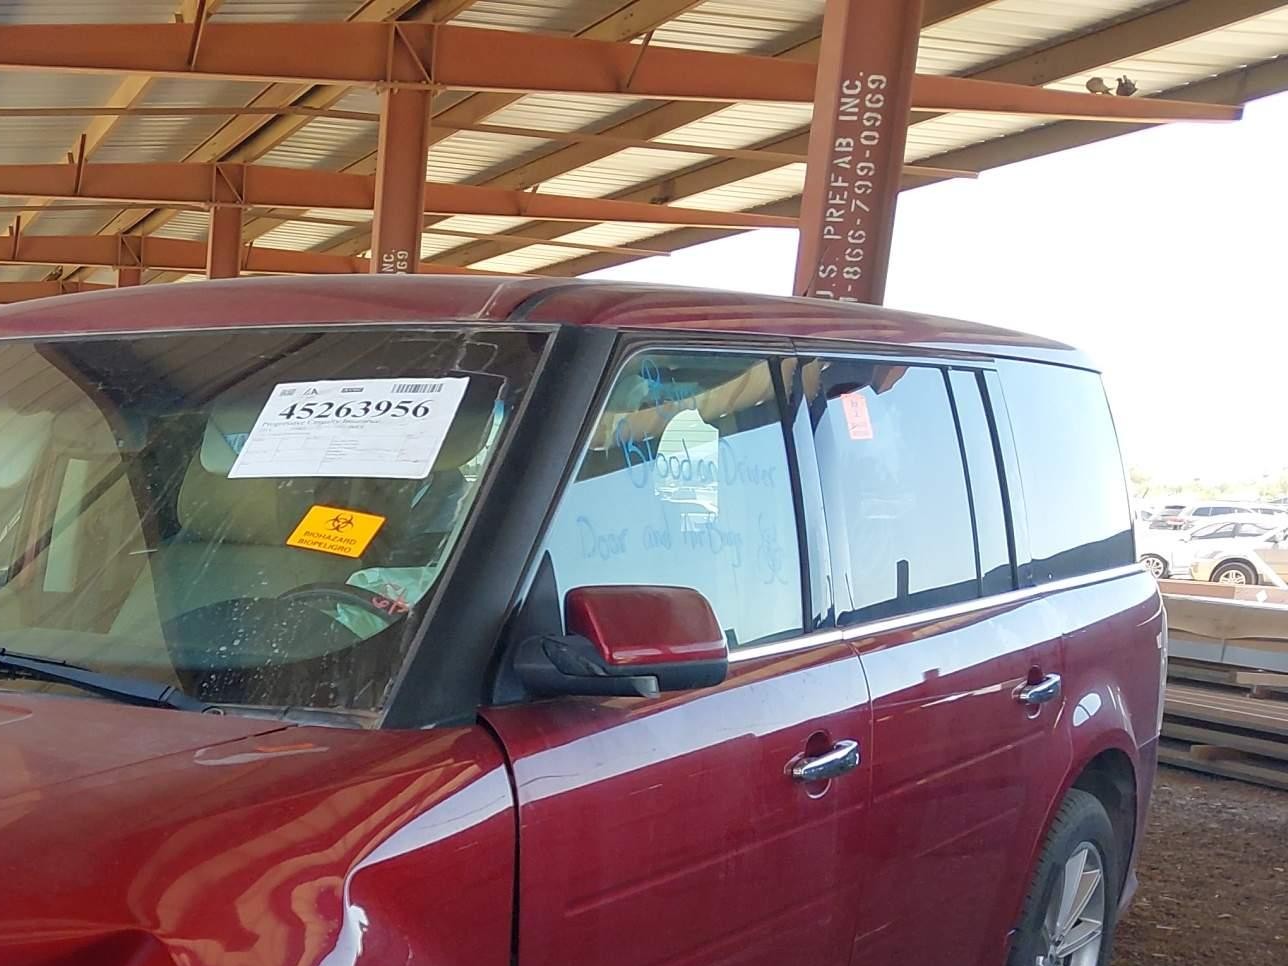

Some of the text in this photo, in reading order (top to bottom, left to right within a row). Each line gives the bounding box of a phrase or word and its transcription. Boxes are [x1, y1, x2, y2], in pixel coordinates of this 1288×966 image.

[823, 136, 855, 240] PREFAB
[839, 71, 864, 121] INC.
[839, 74, 887, 302] 1-866-799-0969
[382, 249, 397, 272] NC.
[278, 399, 434, 420] 45263956
[297, 538, 352, 553] BIOPELIGRO
[303, 530, 358, 545] BIOHAZARD
